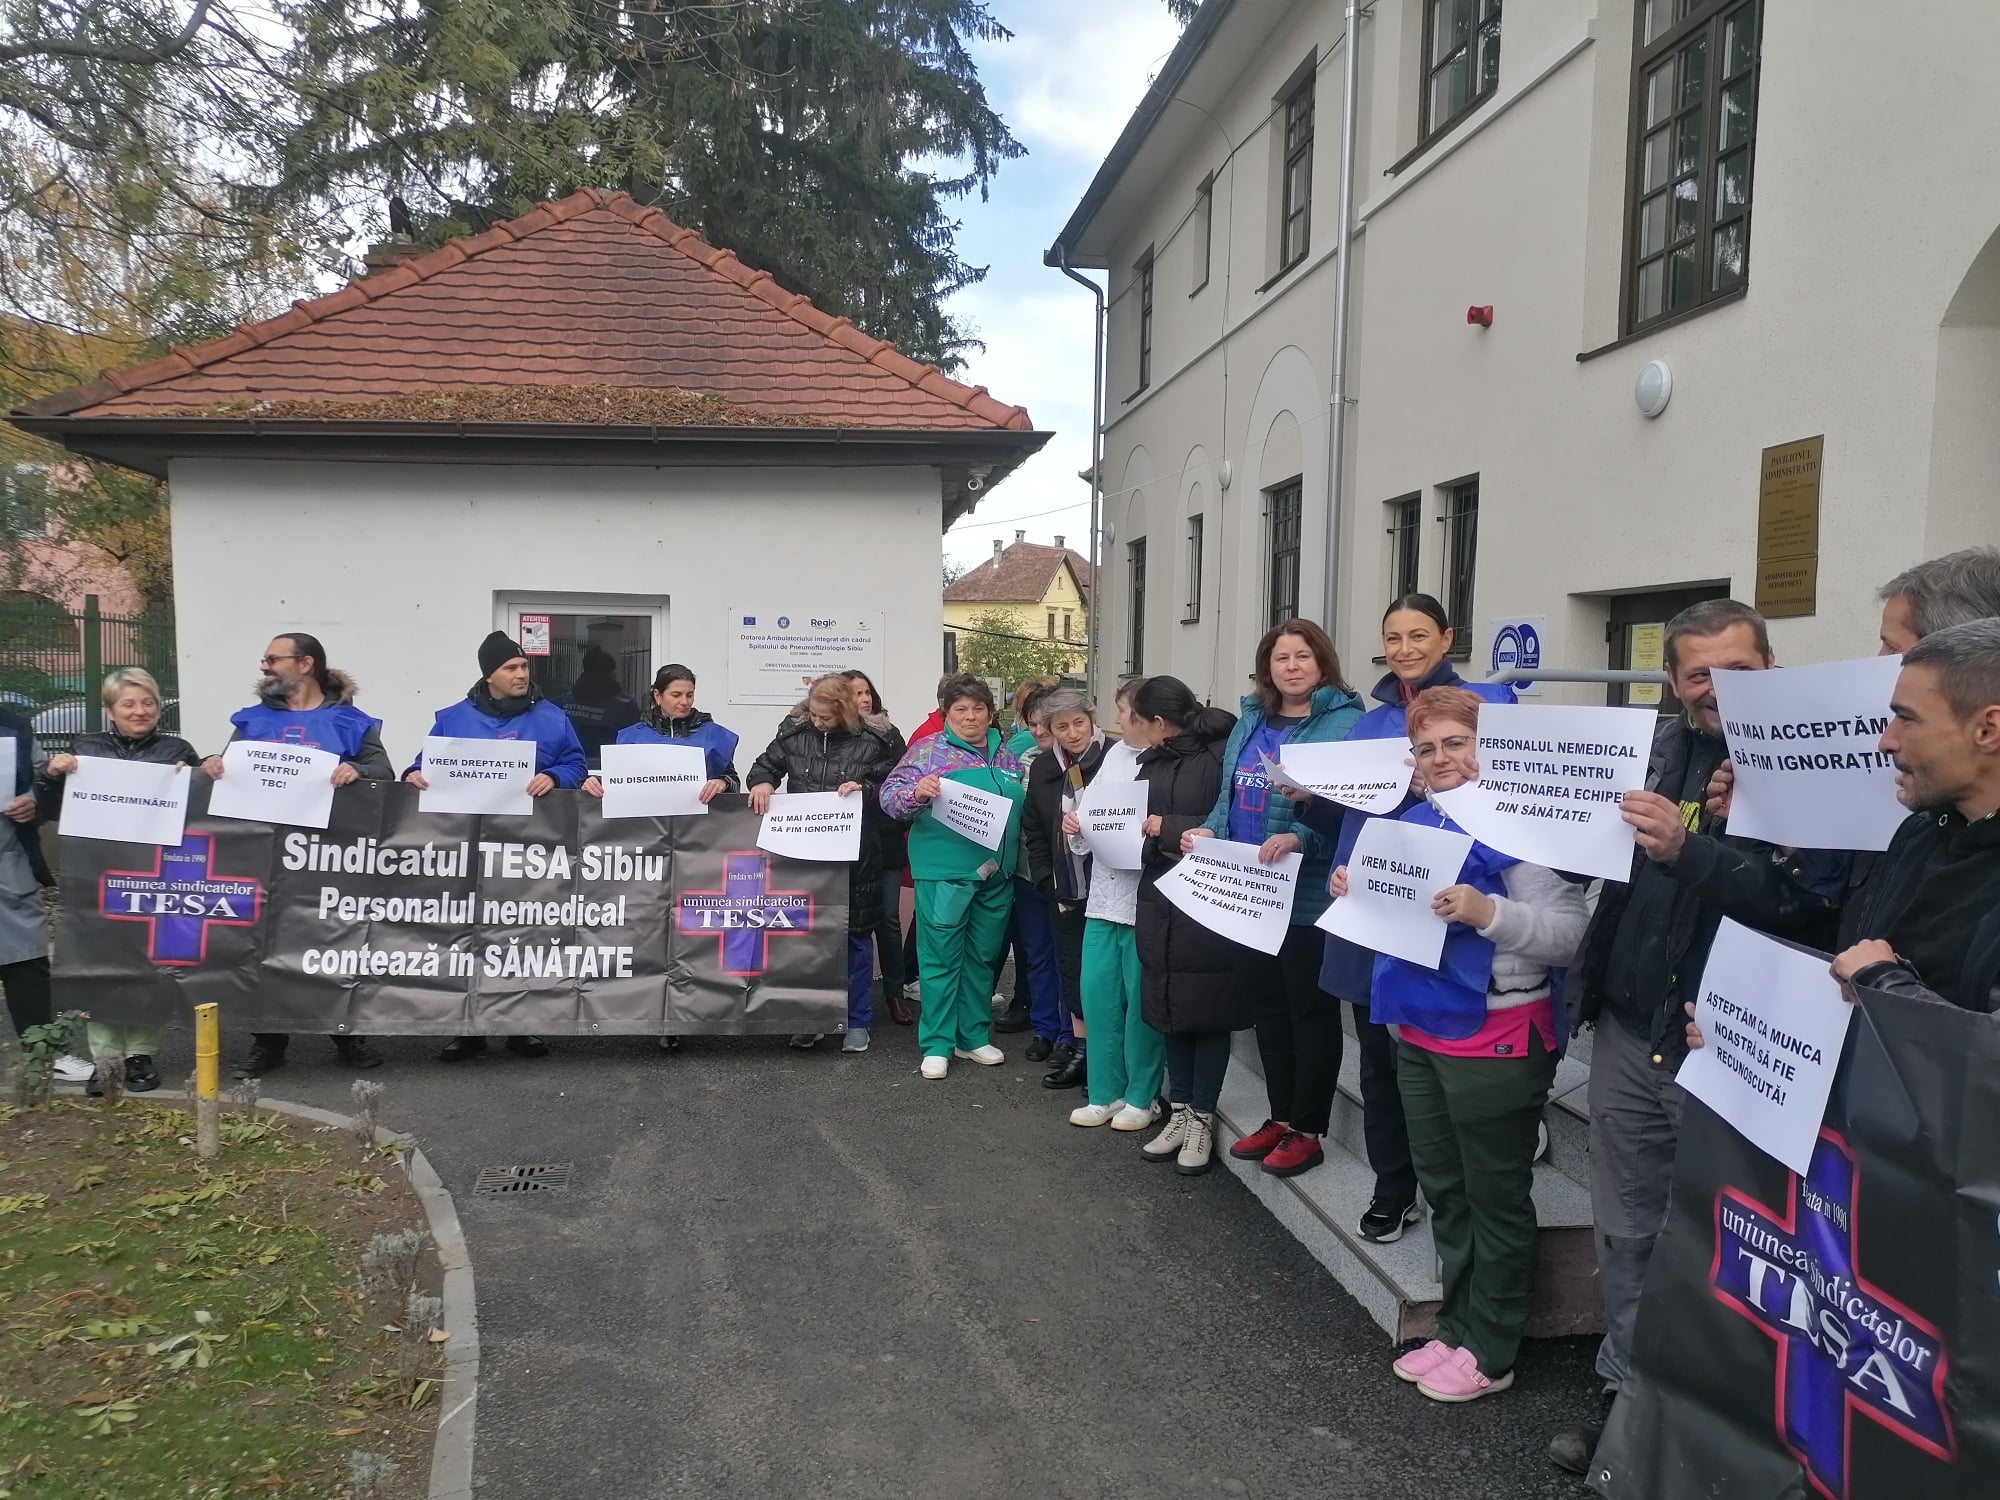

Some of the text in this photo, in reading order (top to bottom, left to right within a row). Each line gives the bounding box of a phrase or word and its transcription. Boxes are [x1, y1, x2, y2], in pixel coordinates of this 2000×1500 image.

[810, 618, 837, 628] Regio
[748, 643, 779, 651] Spitalului
[1726, 715, 1889, 740] NU MAI ACCEPTĂM
[246, 749, 311, 765] VREM SPOR
[1479, 737, 1638, 758] PERSONALUL NEMEDICAL
[253, 763, 299, 776] PENTRU
[428, 758, 458, 766] VREM
[461, 759, 514, 768] DREPTATE
[1492, 759, 1614, 780] ESTE VITAL PENTRU
[1734, 748, 1750, 767] SĂ
[1750, 753, 1773, 770] FIM
[260, 779, 287, 789] TBC!
[449, 769, 507, 779] SĂNĂTATE!
[626, 774, 699, 784] DISCRIMINĂRII!
[1357, 782, 1397, 790] MUNCA
[1477, 779, 1570, 799] FUNCȚIONAREA
[72, 791, 178, 808] NU DISCRIMINĂRII!
[962, 793, 989, 806] MEREU
[786, 814, 802, 822] MAI
[805, 811, 854, 821] ACCEPTĂM
[1088, 807, 1137, 817] VREM SALARII
[1495, 801, 1592, 823] DIN SĂNĂTATE!
[1092, 822, 1126, 832] DECENTE!
[282, 832, 664, 881] Sindicatul TESA Sibiu
[1188, 854, 1291, 882] PERSONALUL NEMEDICAL
[1361, 854, 1430, 881] VREM SALARII
[107, 876, 254, 896] uniunea sindicatelor
[1178, 872, 1285, 910] FUNCȚIONAREA ECHIPEI
[1194, 868, 1278, 894] ESTE VITAL PENTRU
[1367, 878, 1416, 901] DECENTE!
[121, 891, 240, 918] TESA
[318, 886, 626, 927] Personalul nemedical
[683, 895, 807, 907] uniunea sindicatelor
[1191, 890, 1263, 920] DIN SĂNĂTATE!
[695, 908, 794, 928] TESA
[301, 936, 634, 978] contează în SĂNĂTATE
[1706, 991, 1822, 1065] AȘTEPTĂM CA MUNCA
[1714, 1020, 1796, 1081] NOASTRĂ SĂ FIE
[1716, 1046, 1787, 1107] RECUNOSCUTĂ!
[1824, 1195, 1831, 1219] in
[1832, 1202, 1847, 1233] 1990
[1722, 1206, 1932, 1371] uniunea sindicatelor
[1738, 1246, 1916, 1418] TESA
